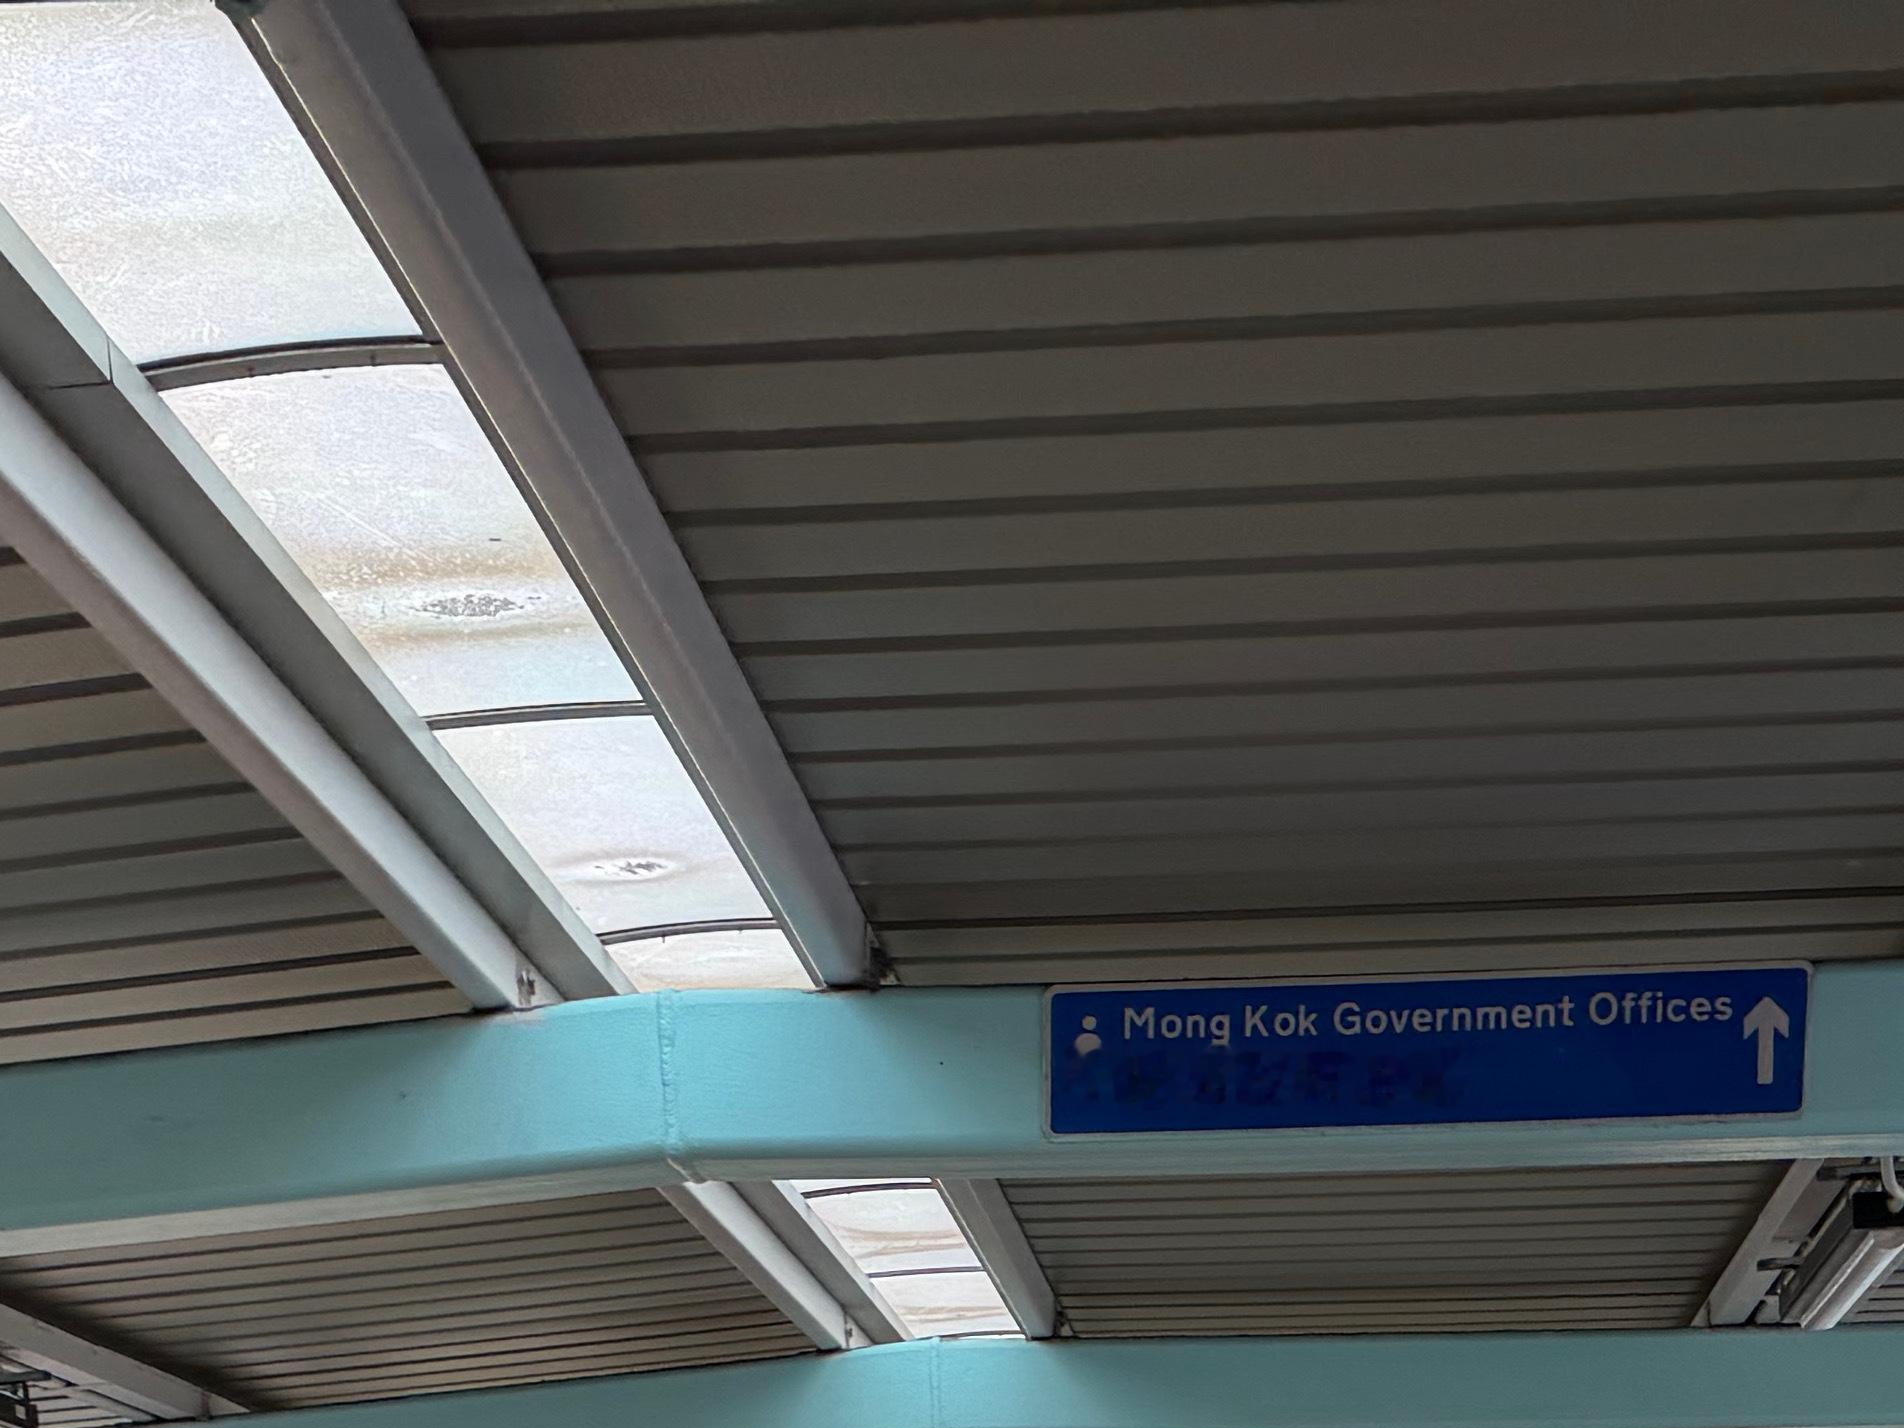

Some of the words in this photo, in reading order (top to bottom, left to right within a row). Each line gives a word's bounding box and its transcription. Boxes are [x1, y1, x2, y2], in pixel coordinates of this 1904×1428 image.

[1123, 1007, 1231, 1046] Mong
[1244, 1003, 1318, 1038] Kok
[1333, 995, 1576, 1037] Government
[1588, 991, 1734, 1026] Offices
